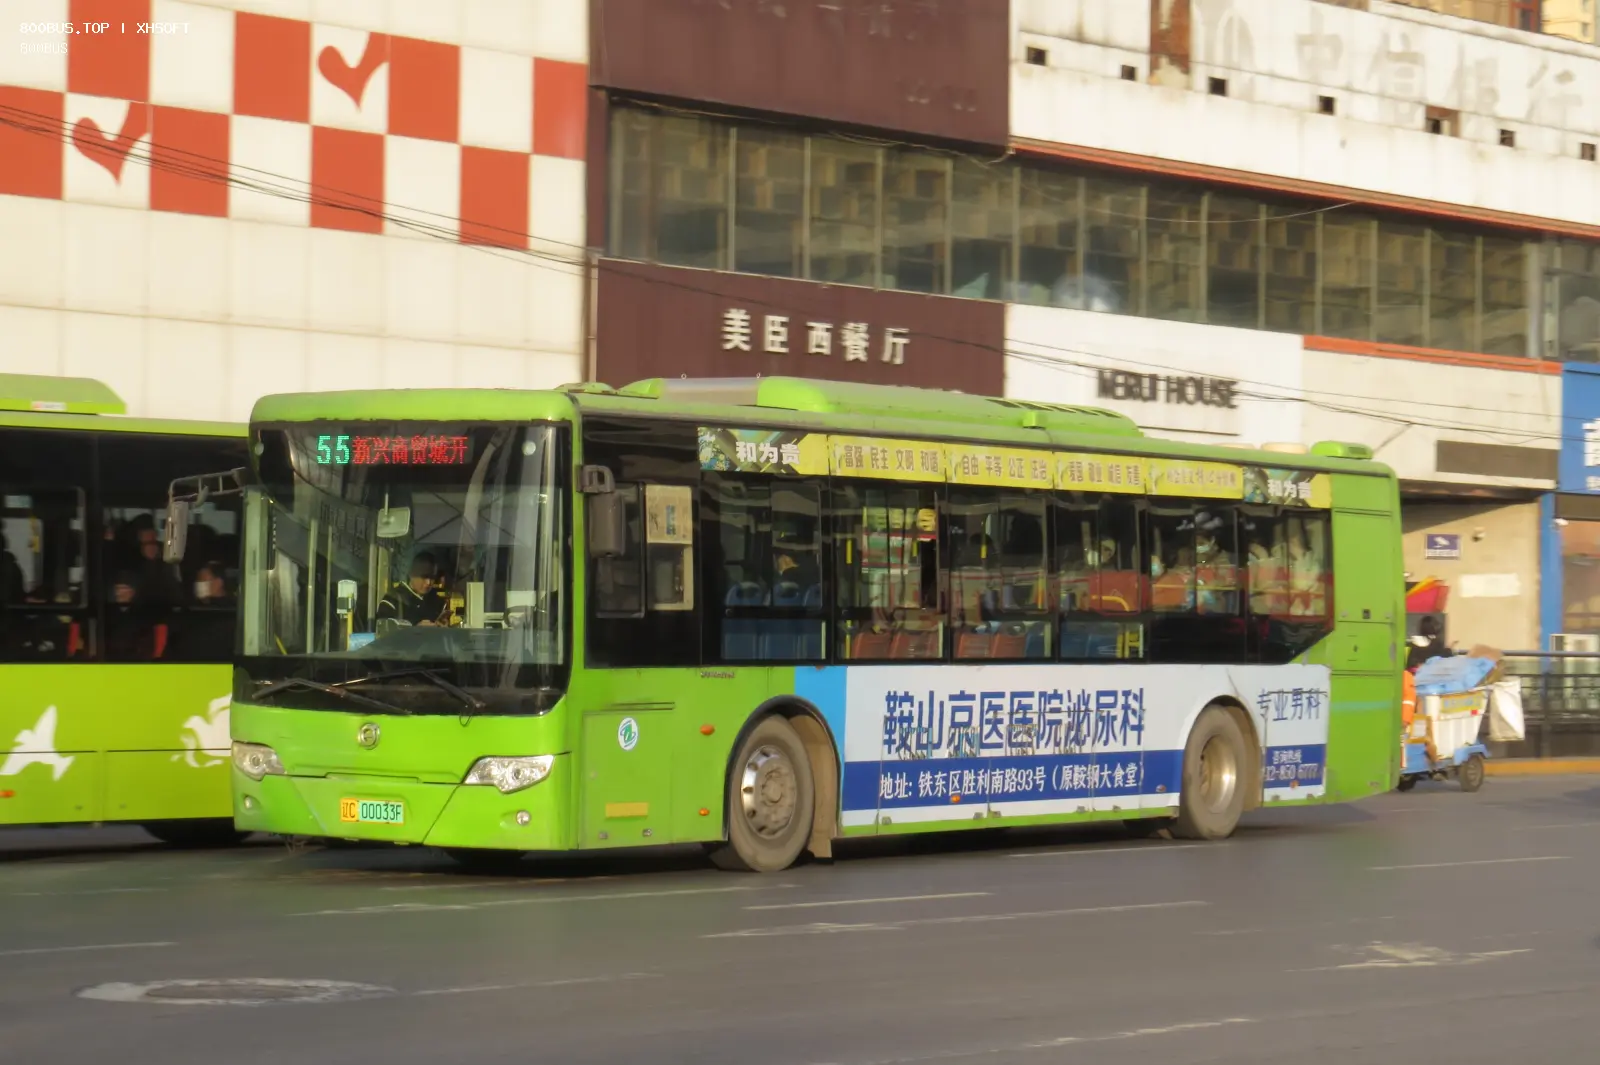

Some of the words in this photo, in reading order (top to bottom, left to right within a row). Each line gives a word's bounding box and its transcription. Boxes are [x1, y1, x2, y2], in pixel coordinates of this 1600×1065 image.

[721, 307, 910, 365] 美臣西餐厅
[1165, 375, 1238, 409] HOUSE
[316, 435, 349, 464] 55
[736, 440, 800, 465] 和为贵
[844, 445, 864, 468] 富强
[871, 446, 889, 470] 民主
[895, 449, 914, 471] 文明
[962, 454, 979, 476] 自由
[985, 455, 1002, 477] 平等
[1008, 457, 1025, 479] 公正
[1257, 688, 1321, 721] 专业男科
[883, 688, 1146, 755] 鞍山京医医院泌尿科
